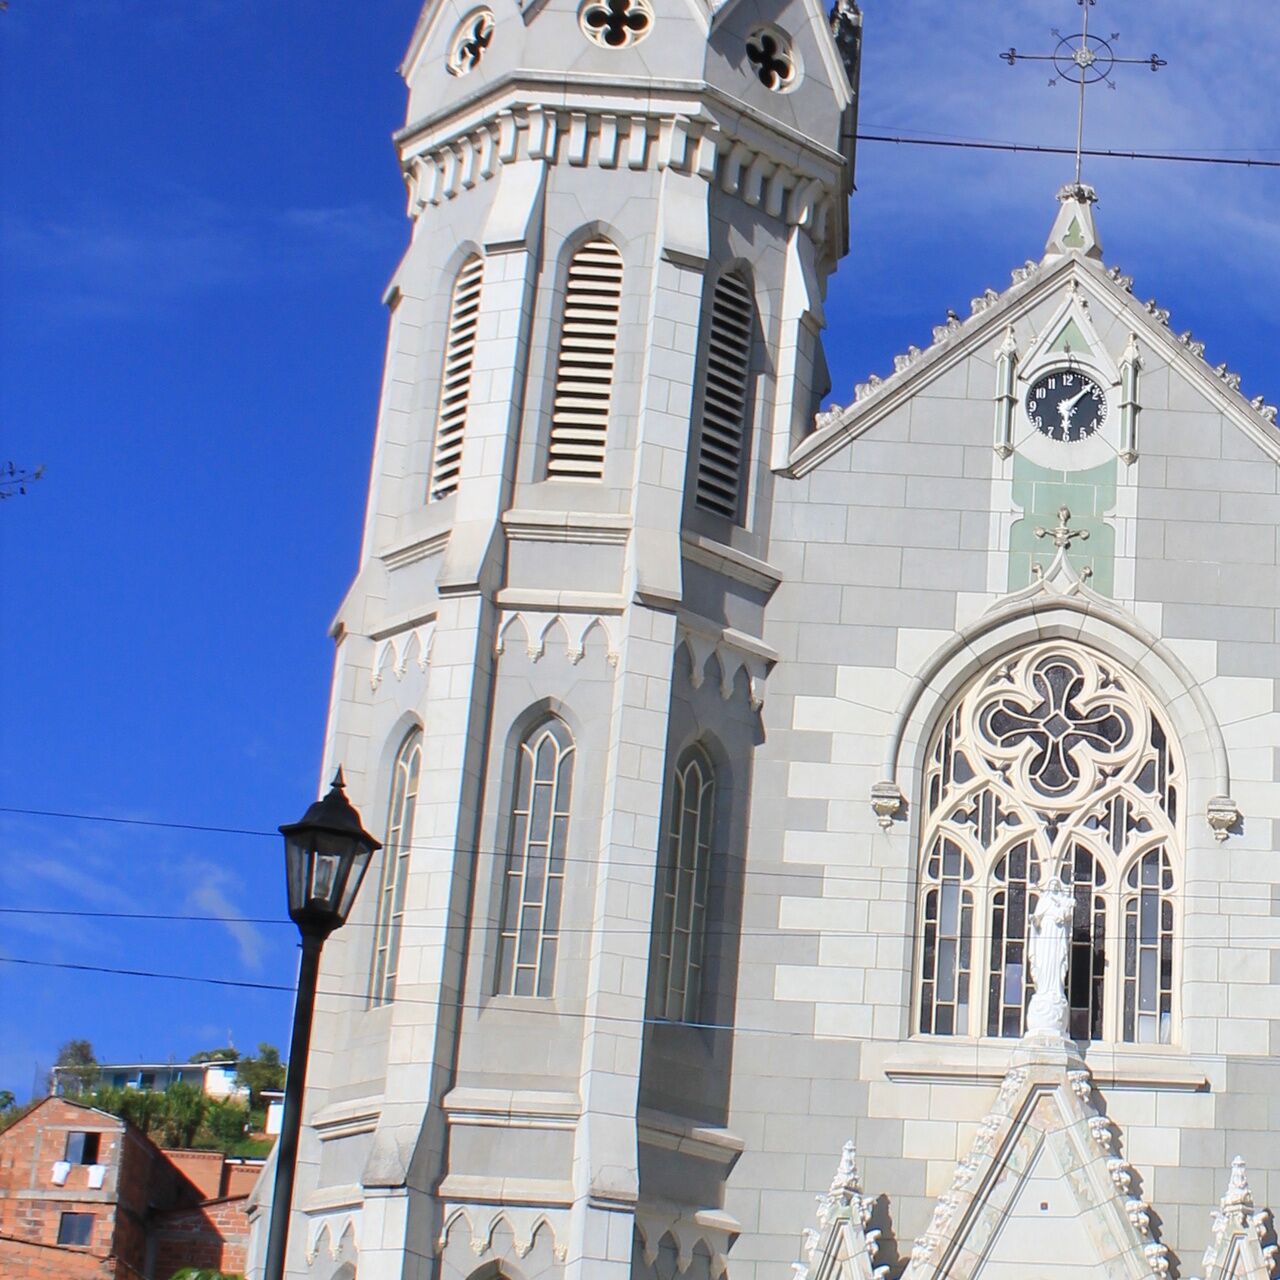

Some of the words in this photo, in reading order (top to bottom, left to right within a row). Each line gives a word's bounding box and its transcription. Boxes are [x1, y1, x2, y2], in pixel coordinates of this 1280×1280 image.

[1048, 378, 1055, 390] 11
[1062, 374, 1073, 386] 12
[1036, 387, 1046, 399] 10
[1092, 389, 1099, 400] 2
[1029, 401, 1037, 412] 9
[1035, 416, 1042, 428] 8
[1047, 427, 1055, 438] 7
[1063, 431, 1069, 441] 6
[1080, 427, 1086, 439] 5
